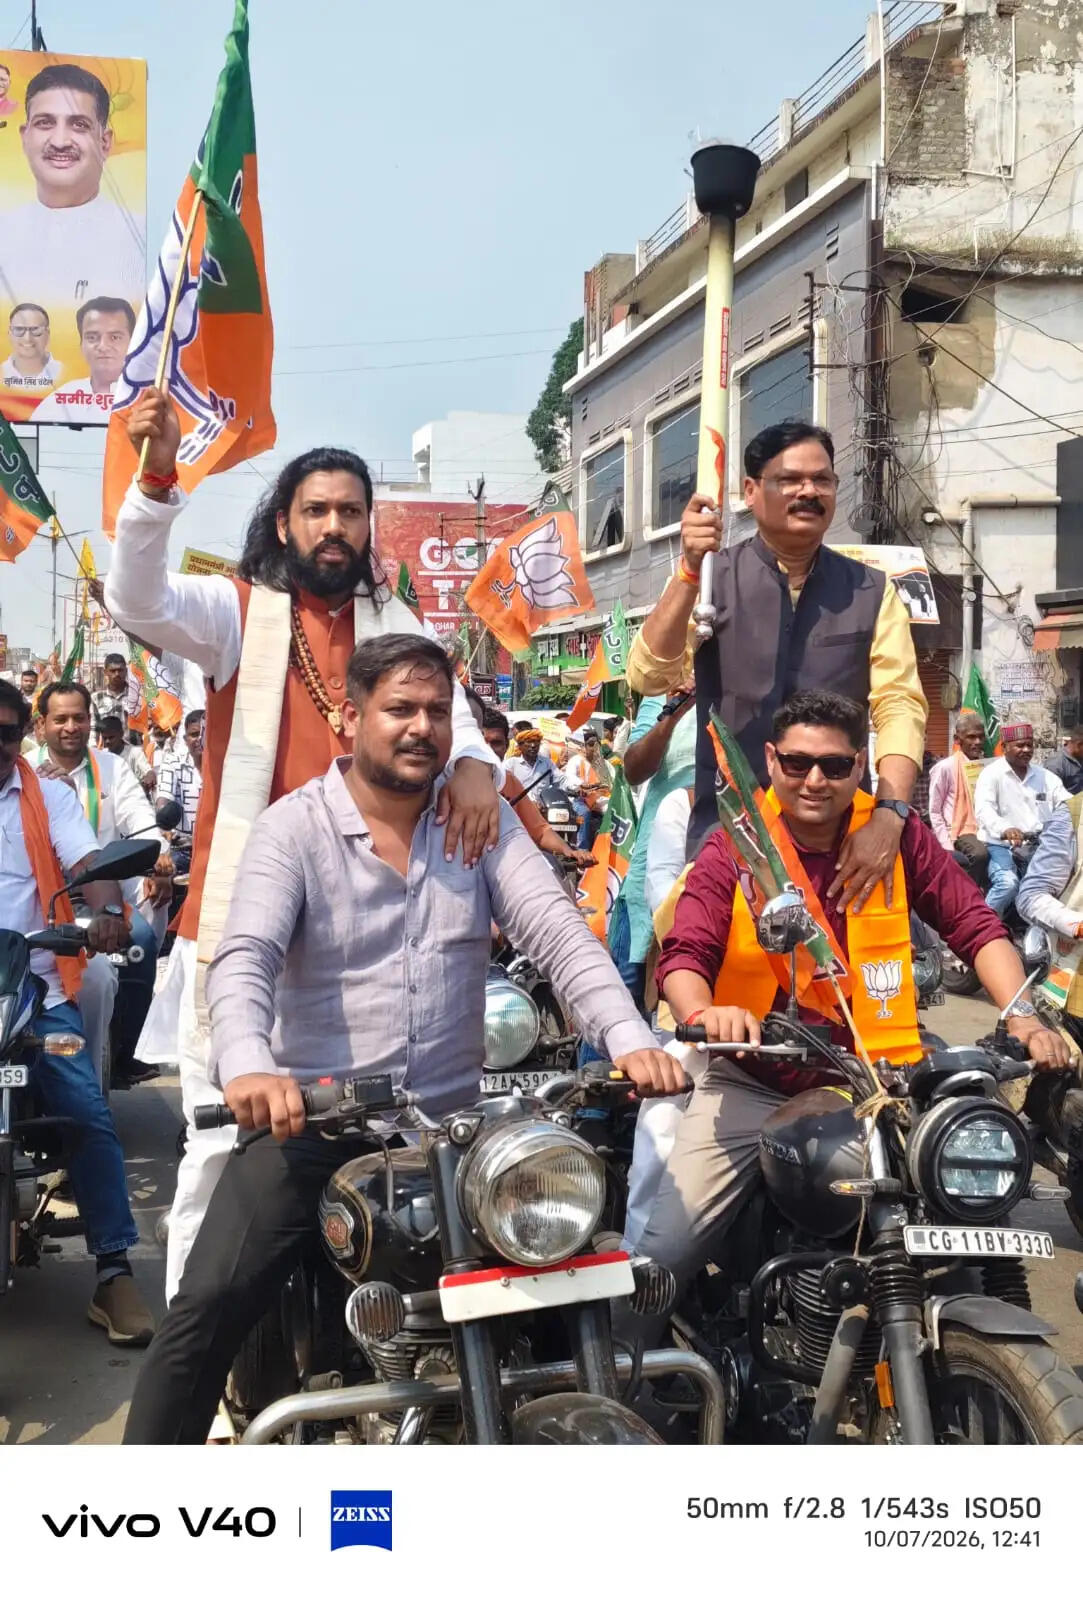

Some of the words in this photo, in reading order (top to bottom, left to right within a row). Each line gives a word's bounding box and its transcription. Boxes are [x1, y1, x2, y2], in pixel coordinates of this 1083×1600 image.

[55, 389, 93, 404] समीर
[0, 1069, 22, 1084] 59
[929, 1231, 952, 1250] CG
[1012, 1233, 1053, 1256] 3330
